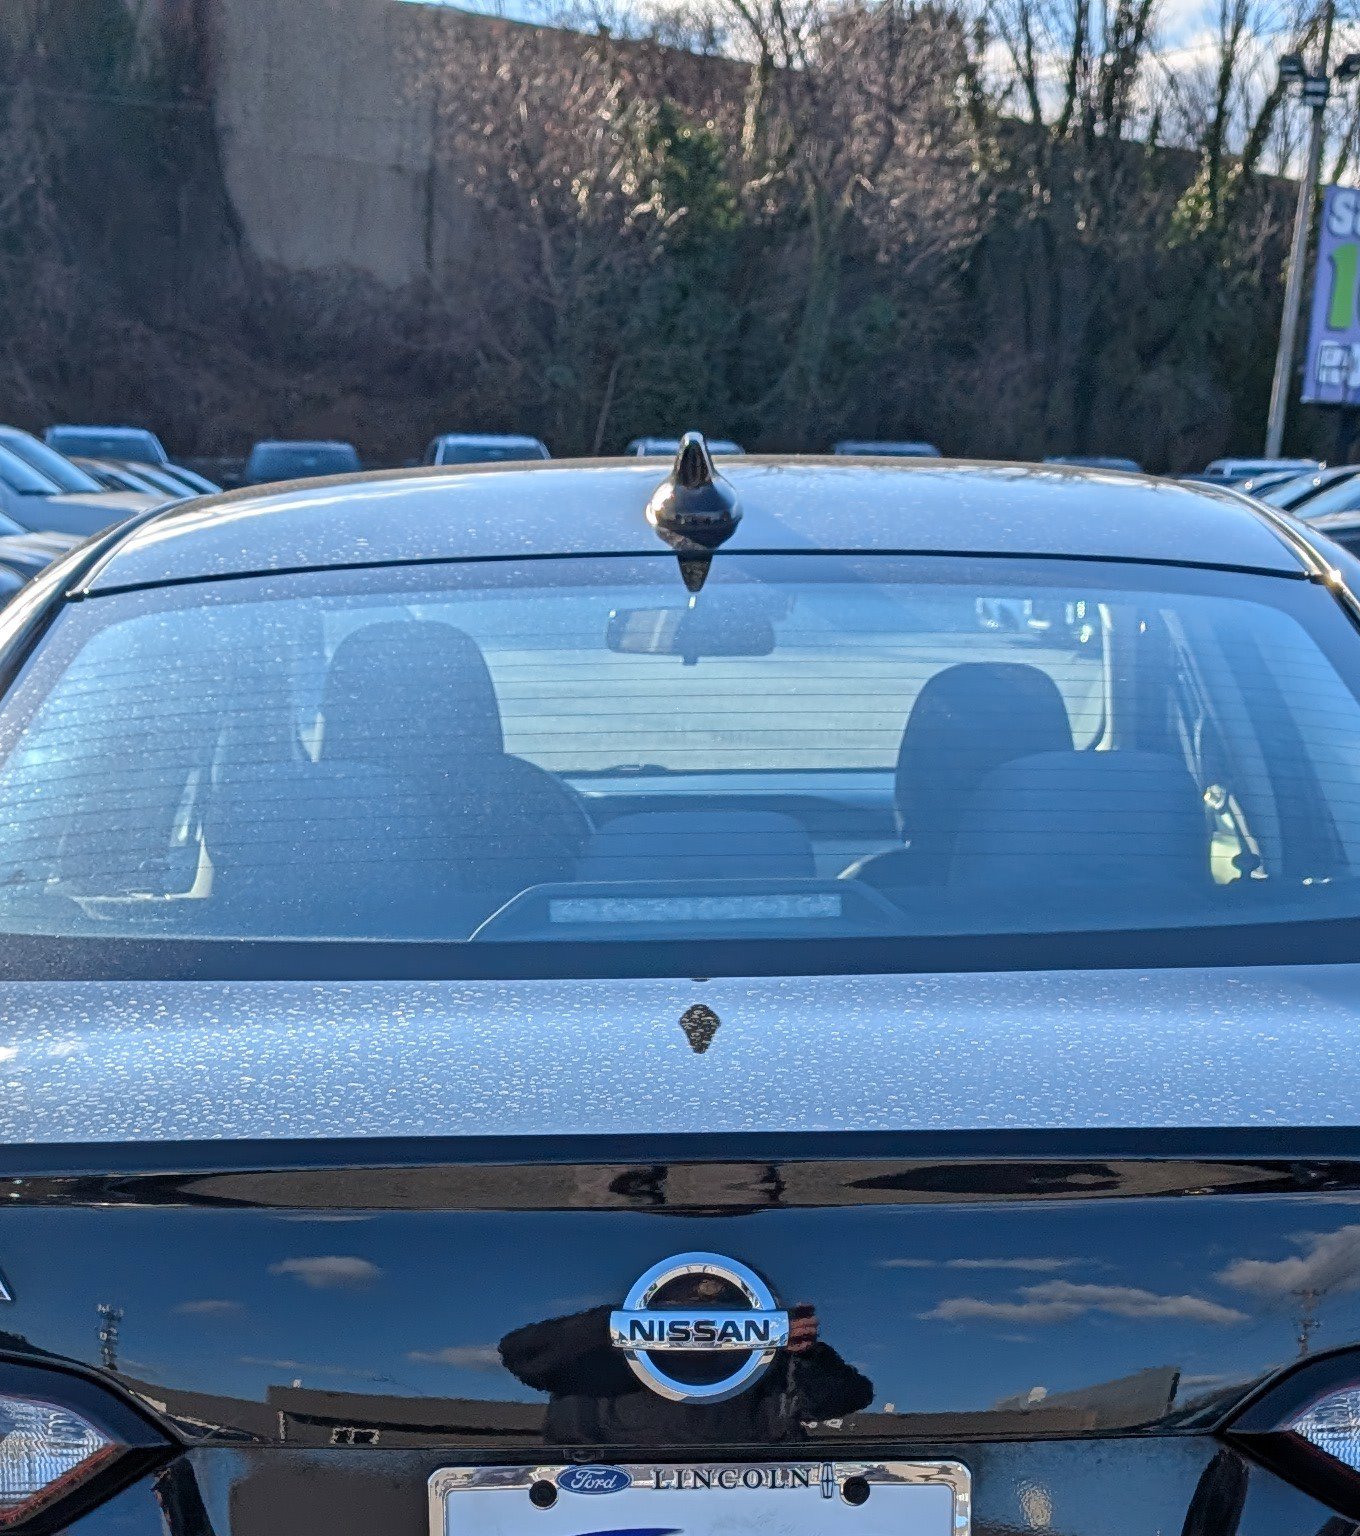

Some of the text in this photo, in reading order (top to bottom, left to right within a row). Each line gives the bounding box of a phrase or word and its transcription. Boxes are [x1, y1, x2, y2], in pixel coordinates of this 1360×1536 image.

[629, 1319, 770, 1342] NISSAN
[570, 1468, 812, 1490] Ford LINCOLN
